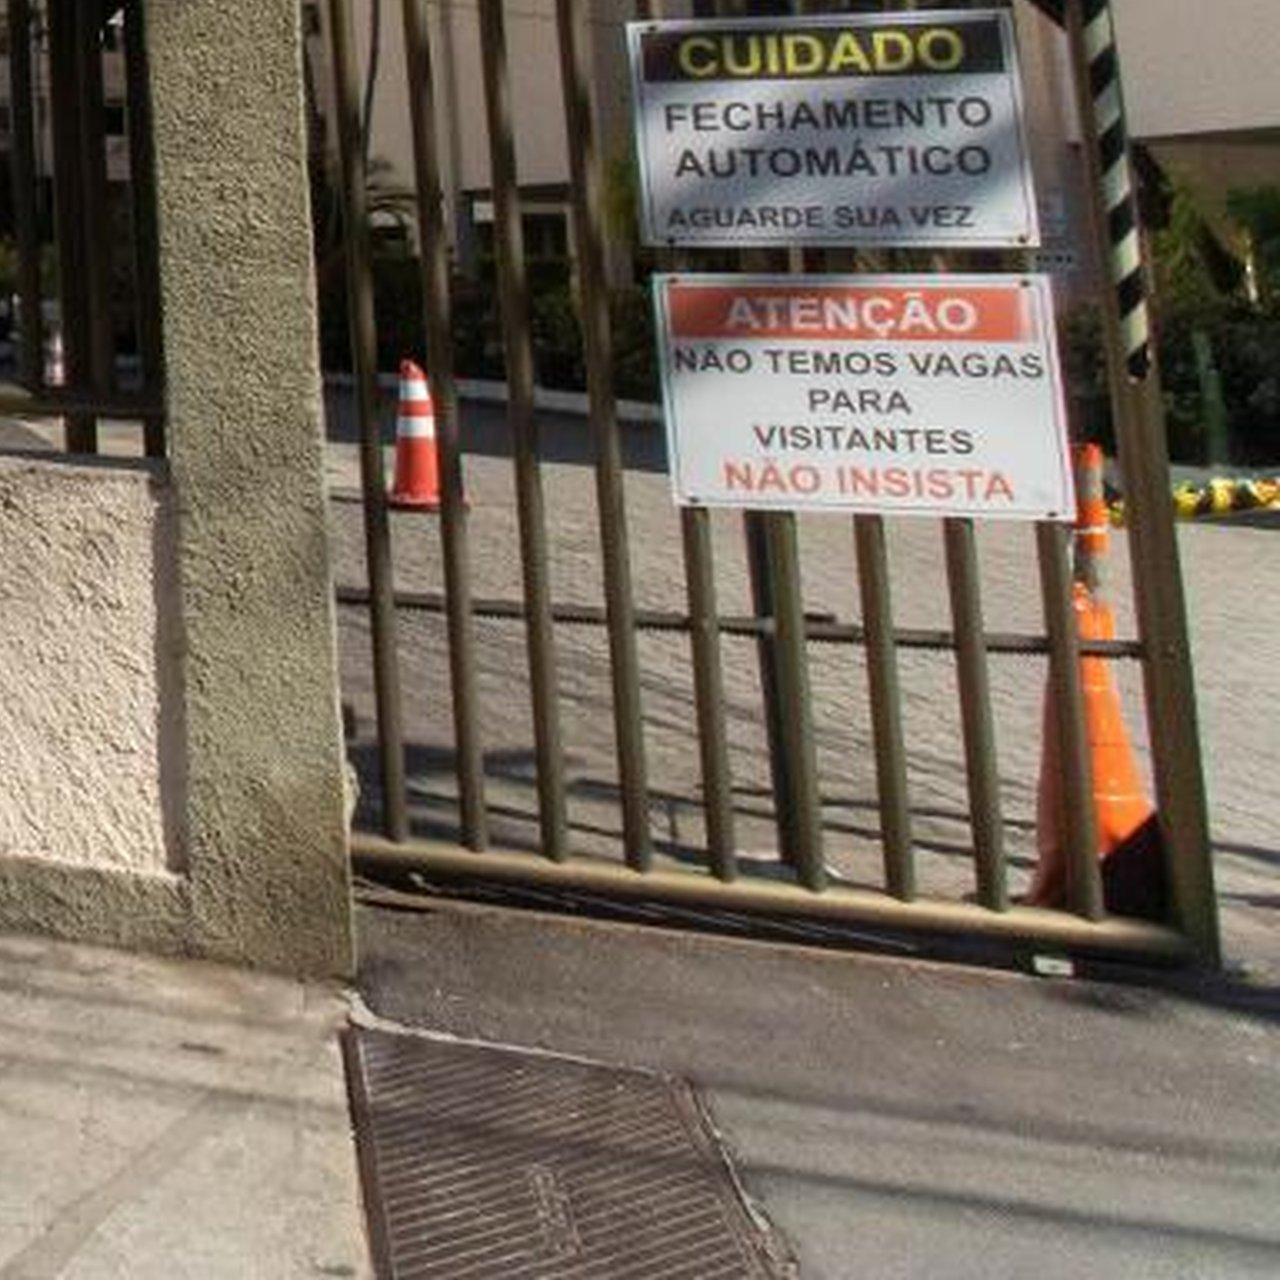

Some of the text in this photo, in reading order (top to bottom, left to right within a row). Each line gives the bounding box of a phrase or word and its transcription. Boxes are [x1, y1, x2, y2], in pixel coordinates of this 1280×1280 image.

[678, 29, 964, 76] CUIDADO
[664, 96, 992, 132] FECHAMENTO
[675, 139, 991, 179] AUTOMÁTICO
[667, 205, 976, 228] AGUARDE SUA VEZ
[726, 292, 977, 337] ATENÇÃO
[674, 344, 1045, 380] NÃO TEMOS VAGAS
[808, 388, 912, 415] PARA
[753, 425, 975, 455] VISITANTES
[724, 459, 1015, 503] NÃO INSISTA
